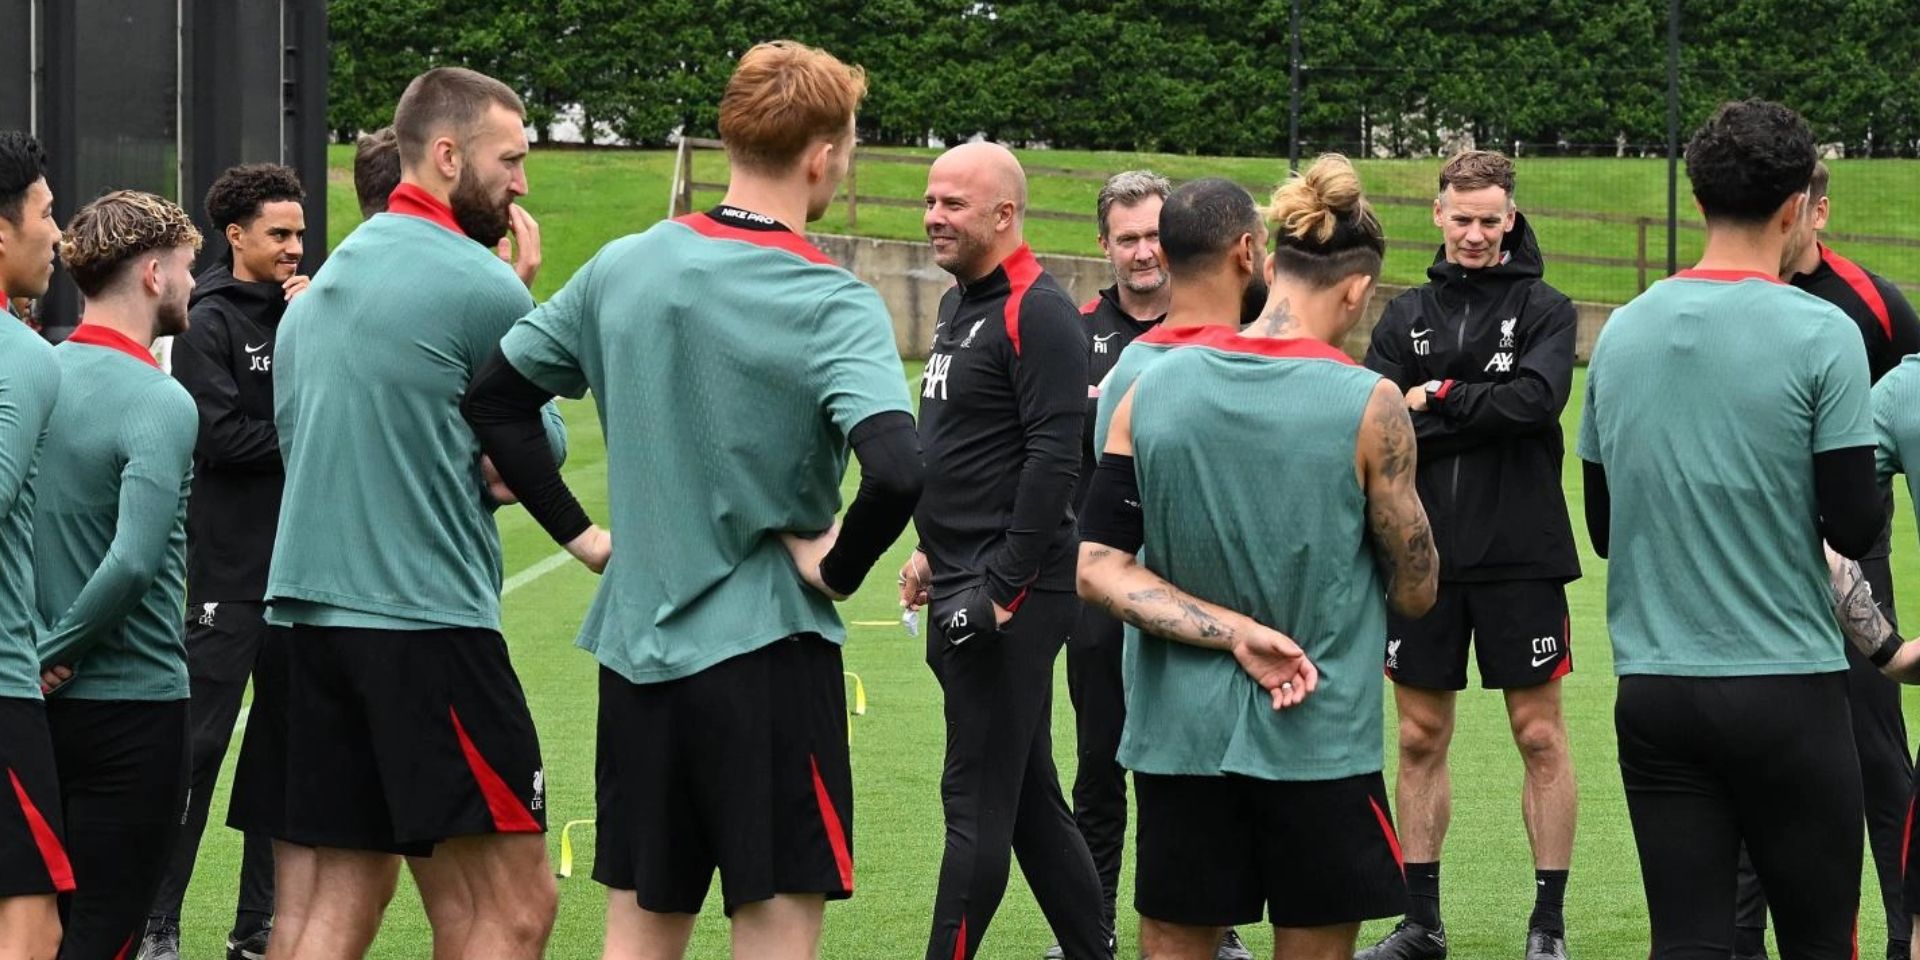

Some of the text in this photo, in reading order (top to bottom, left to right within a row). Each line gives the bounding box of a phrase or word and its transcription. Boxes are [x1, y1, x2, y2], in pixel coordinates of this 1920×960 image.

[721, 208, 775, 225] NIKE PRO
[1094, 341, 1108, 354] AI
[249, 354, 272, 371] JCF
[1531, 636, 1557, 654] CM
